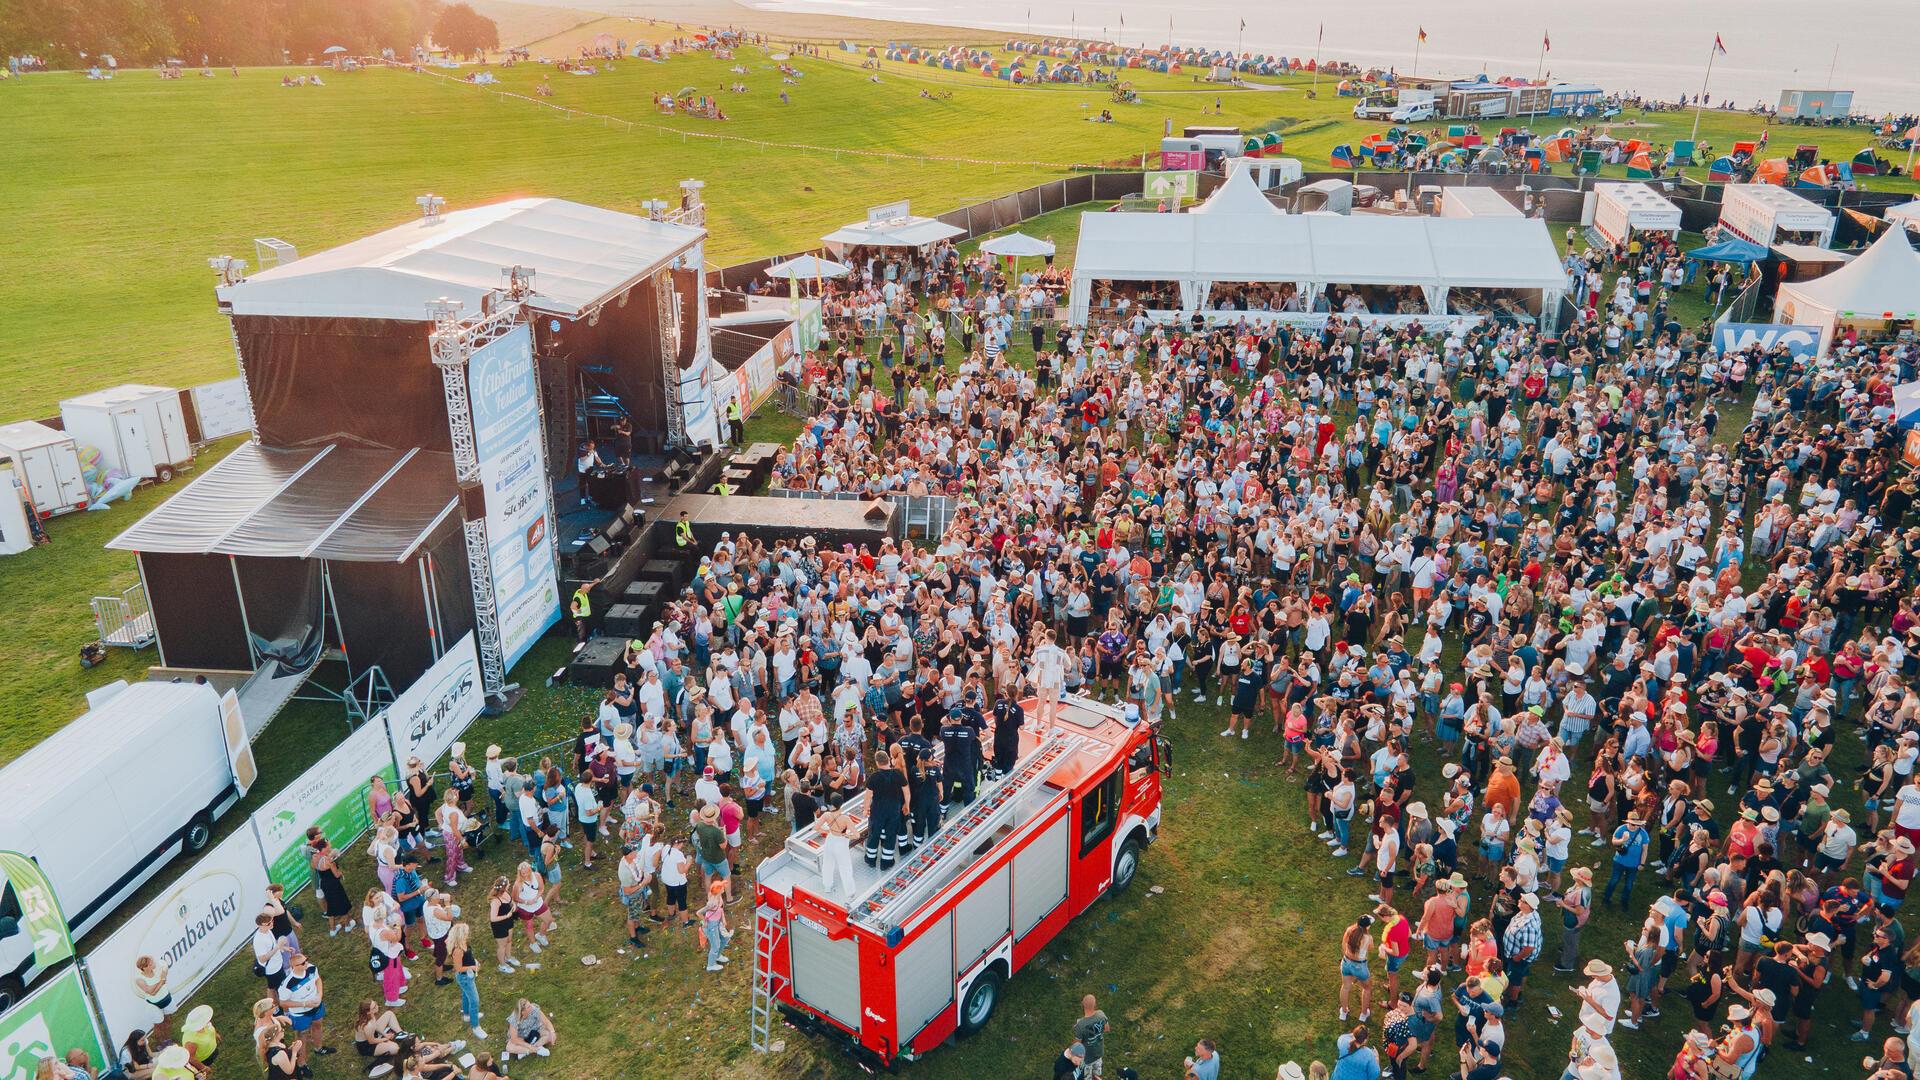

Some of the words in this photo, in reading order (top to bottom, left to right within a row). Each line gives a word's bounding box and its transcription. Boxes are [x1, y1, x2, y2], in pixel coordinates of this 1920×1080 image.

[1723, 329, 1814, 364] WC
[485, 352, 531, 397] Elbstrand
[496, 376, 527, 413] Festival
[160, 892, 237, 969] ombacher
